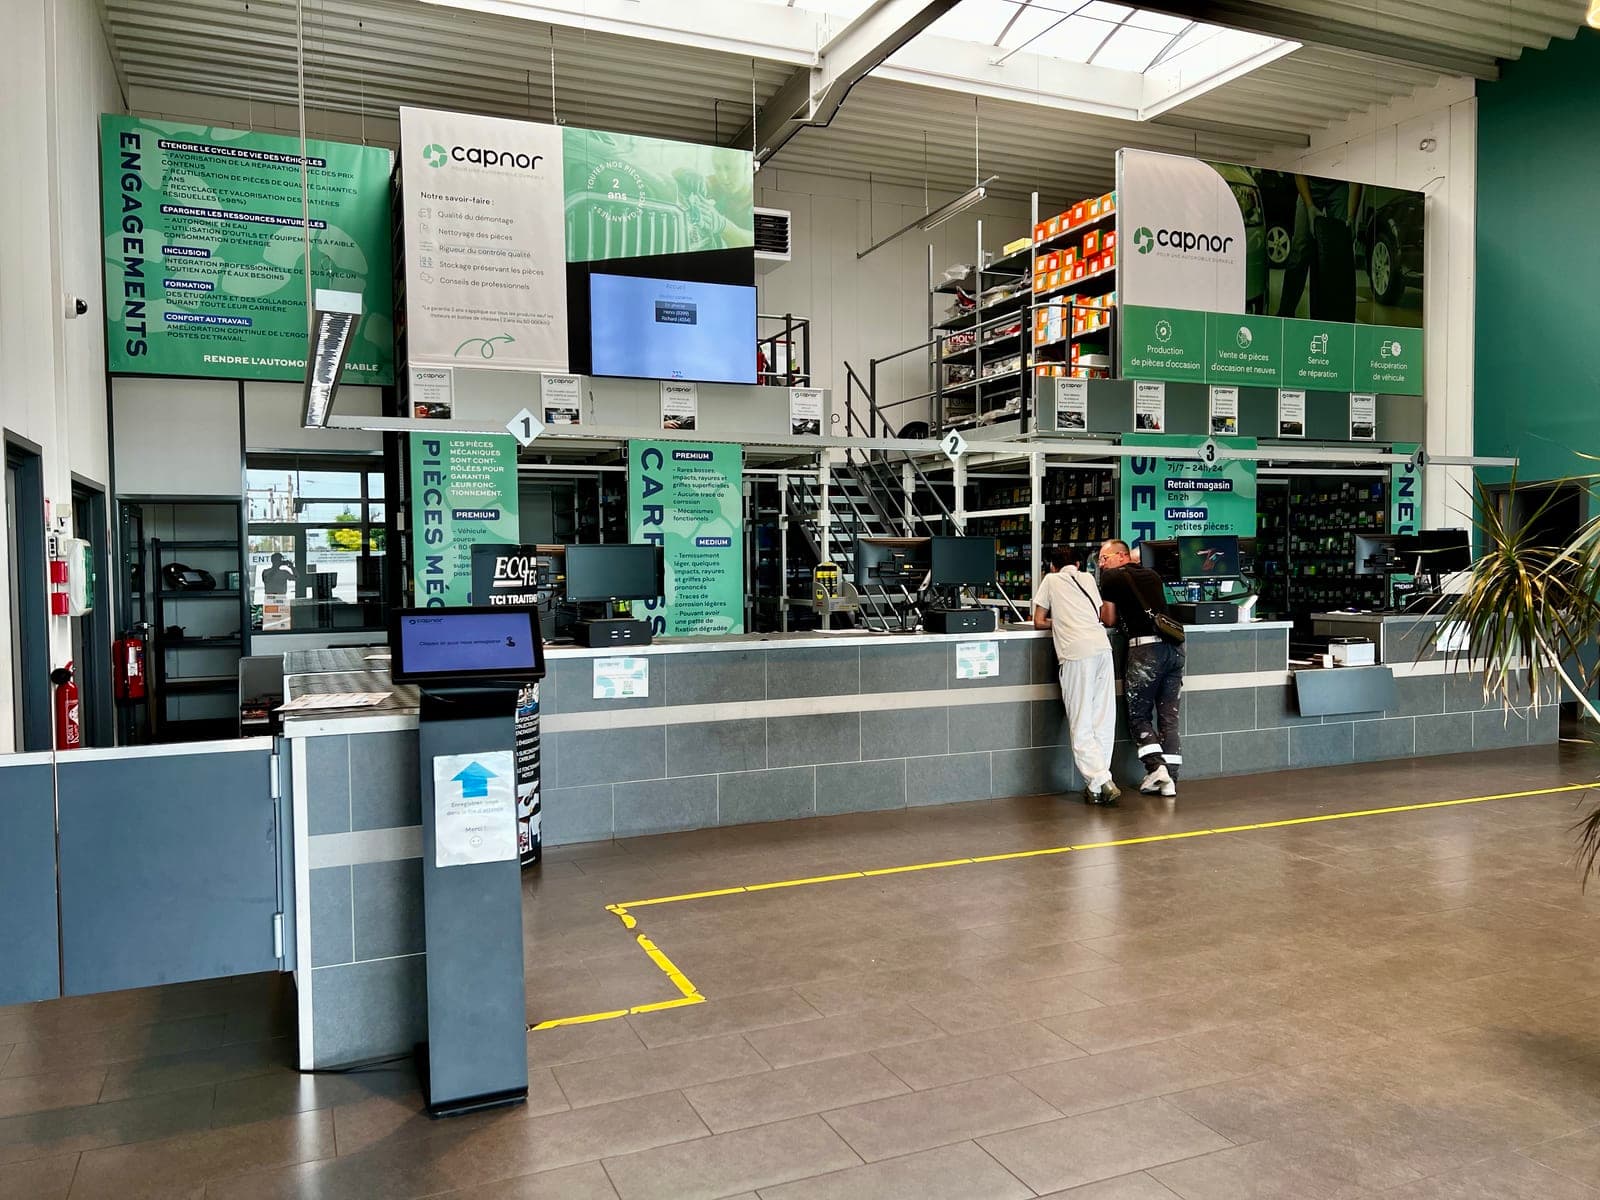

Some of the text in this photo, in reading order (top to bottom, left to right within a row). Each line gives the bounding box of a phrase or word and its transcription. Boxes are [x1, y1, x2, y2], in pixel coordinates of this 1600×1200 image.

[161, 141, 198, 151] ÉTENDRE
[211, 147, 236, 156] CYCLE
[237, 150, 249, 158] DE
[249, 151, 263, 159] VIE
[263, 153, 280, 162] DES
[280, 155, 323, 166] VÉHICLES
[451, 146, 543, 170] capnor
[612, 178, 620, 189] 2
[420, 191, 443, 201] Notre
[607, 191, 627, 201] ans
[207, 210, 222, 218] LES
[223, 212, 276, 224] RESSOURCES
[438, 228, 475, 239] Nettoyage
[476, 231, 488, 239] des
[120, 132, 148, 357] ENGAGEMENTS
[1157, 228, 1234, 253] capnor
[164, 247, 208, 257] INCLUSION
[439, 244, 465, 254] Rigueur
[439, 261, 472, 271] Stockage
[511, 266, 521, 274] les
[165, 280, 212, 290] FORMATION
[439, 276, 530, 290] Conseils de professionnels
[166, 313, 204, 322] CONFORT
[217, 317, 250, 326] TRAVAIL
[1147, 344, 1184, 356] Production
[203, 354, 250, 365] RENDRE
[1219, 350, 1269, 362] Vente de pièces
[1307, 356, 1330, 366] Service
[1131, 357, 1141, 366] de
[1141, 359, 1165, 369] pièces
[1245, 365, 1253, 373] et
[1253, 366, 1276, 375] neuves
[1298, 368, 1338, 379] de réparation
[1372, 372, 1381, 381] de
[520, 416, 531, 439] 1
[465, 440, 494, 448] PIÈCES
[949, 436, 959, 455] 2
[449, 448, 501, 456] MÉCANIQUES
[675, 451, 710, 460] PREMIUM
[1206, 444, 1215, 461] 3
[1417, 450, 1424, 467] 4
[450, 464, 482, 472] RÔLÉES
[1167, 464, 1184, 473] 7j/7
[1167, 480, 1230, 491] Retrait magasin
[422, 439, 446, 545] PIÈCES
[1167, 493, 1190, 501] En 2h
[455, 511, 496, 519] PREMIUM
[1167, 509, 1204, 518] Livraison
[1174, 522, 1229, 532] petites pièces
[701, 568, 725, 576] rayures
[702, 576, 716, 584] plus
[489, 594, 506, 605] TCI
